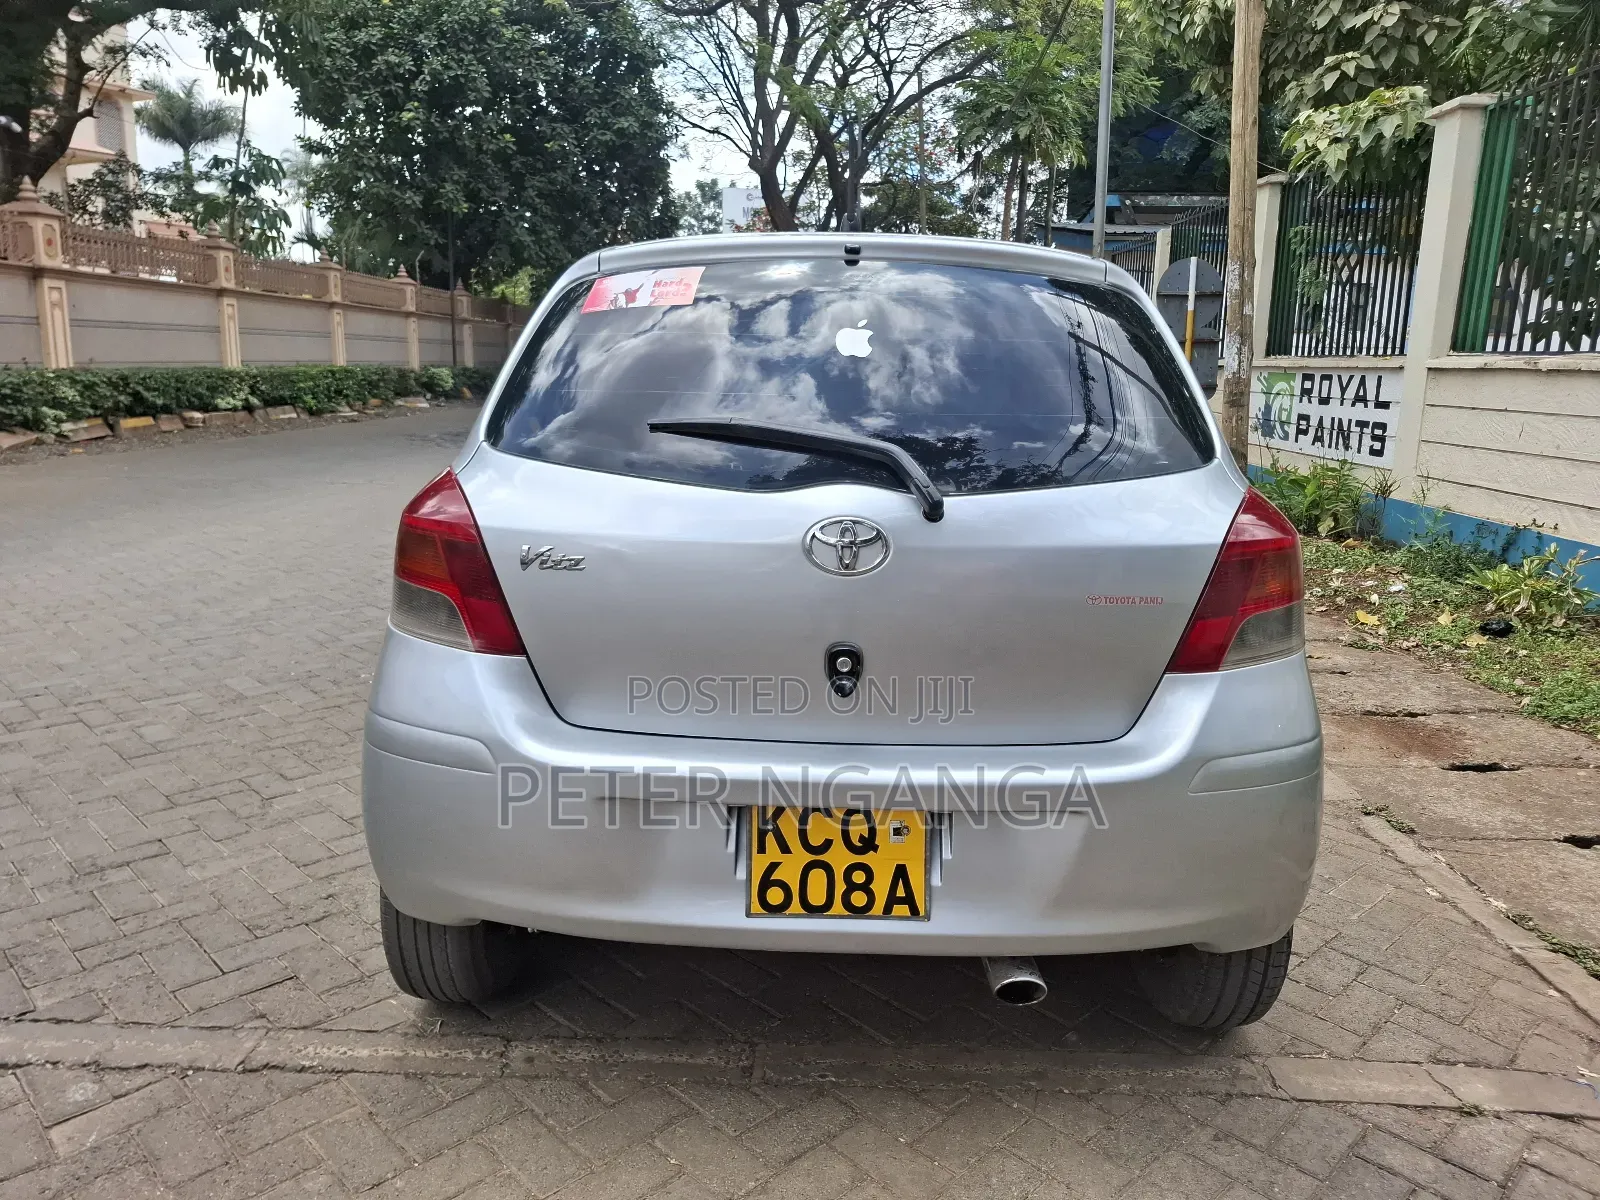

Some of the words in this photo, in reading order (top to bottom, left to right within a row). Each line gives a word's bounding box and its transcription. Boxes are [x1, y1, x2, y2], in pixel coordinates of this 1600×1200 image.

[1299, 373, 1392, 410] ROYAL
[1294, 413, 1388, 457] PAINTS
[520, 544, 586, 571] Vitz
[1104, 596, 1137, 605] TOYOTA
[756, 806, 880, 855] KCQ
[756, 860, 920, 916] 608A
